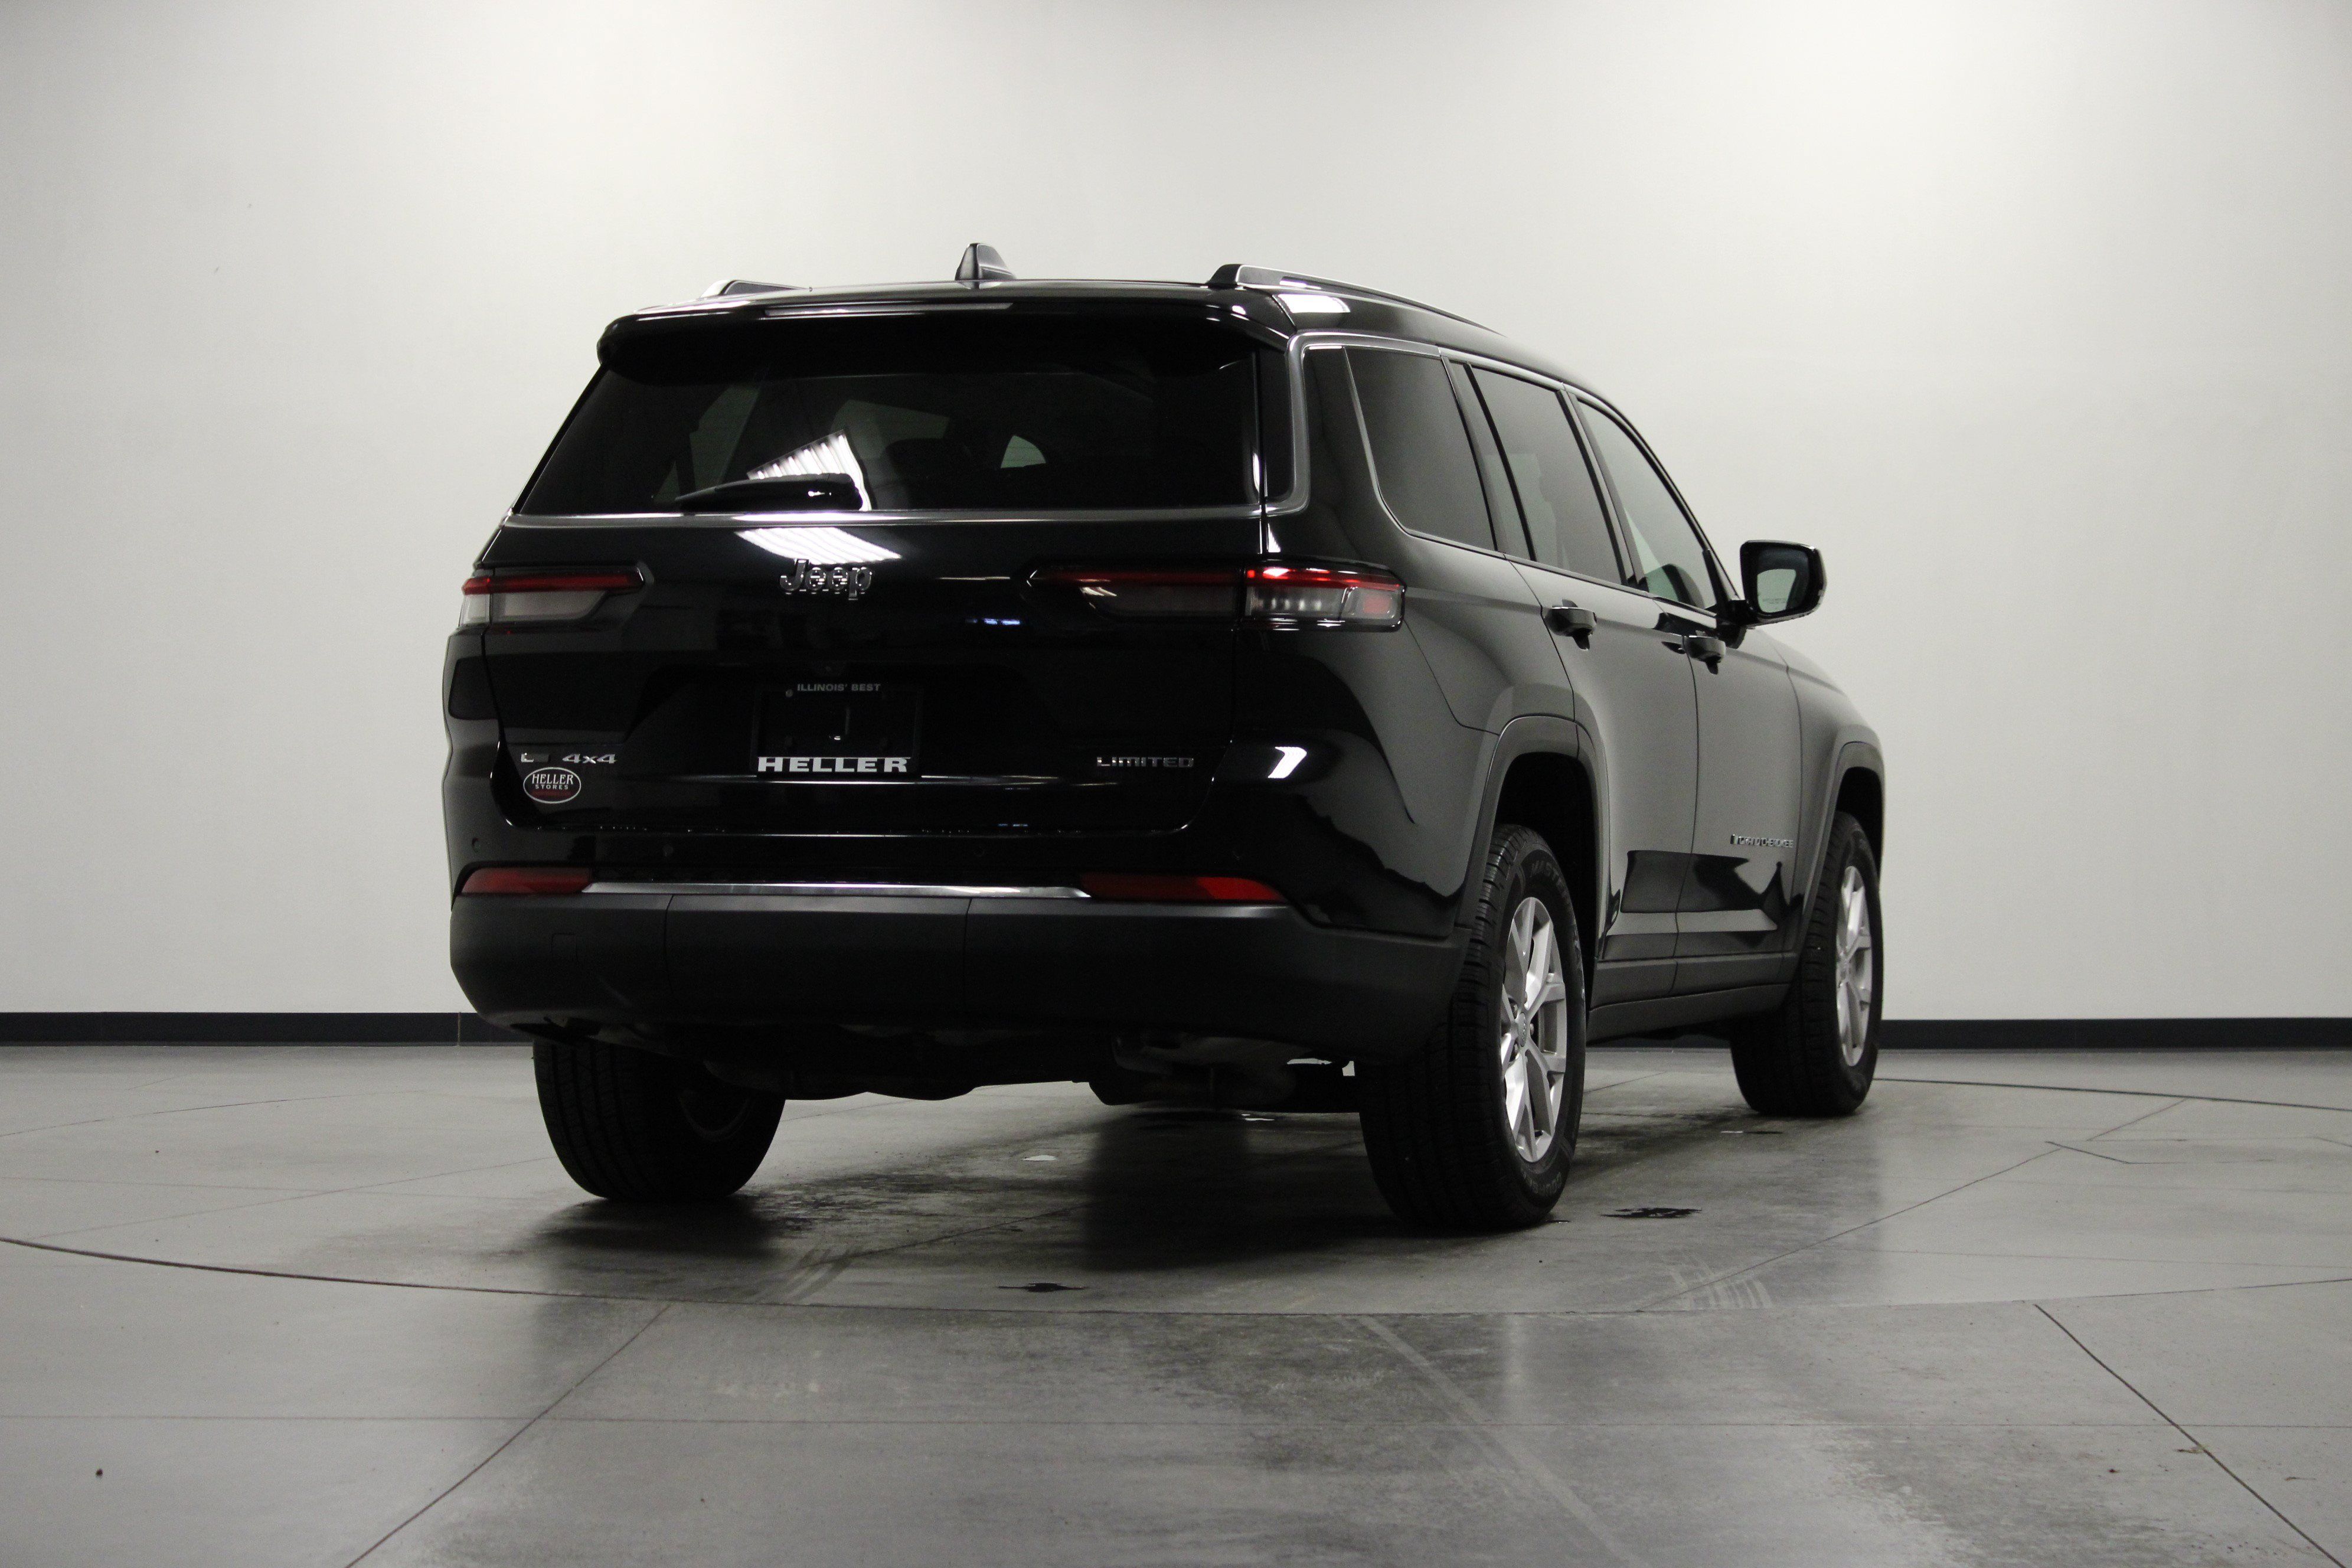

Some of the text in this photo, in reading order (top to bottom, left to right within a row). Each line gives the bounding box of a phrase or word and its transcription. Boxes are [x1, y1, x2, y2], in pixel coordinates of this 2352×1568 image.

[779, 558, 874, 600] Jeep
[851, 683, 881, 692] BEST
[757, 757, 909, 772] HELLER
[1096, 756, 1194, 767] LIMITED
[531, 773, 574, 785] HELLER
